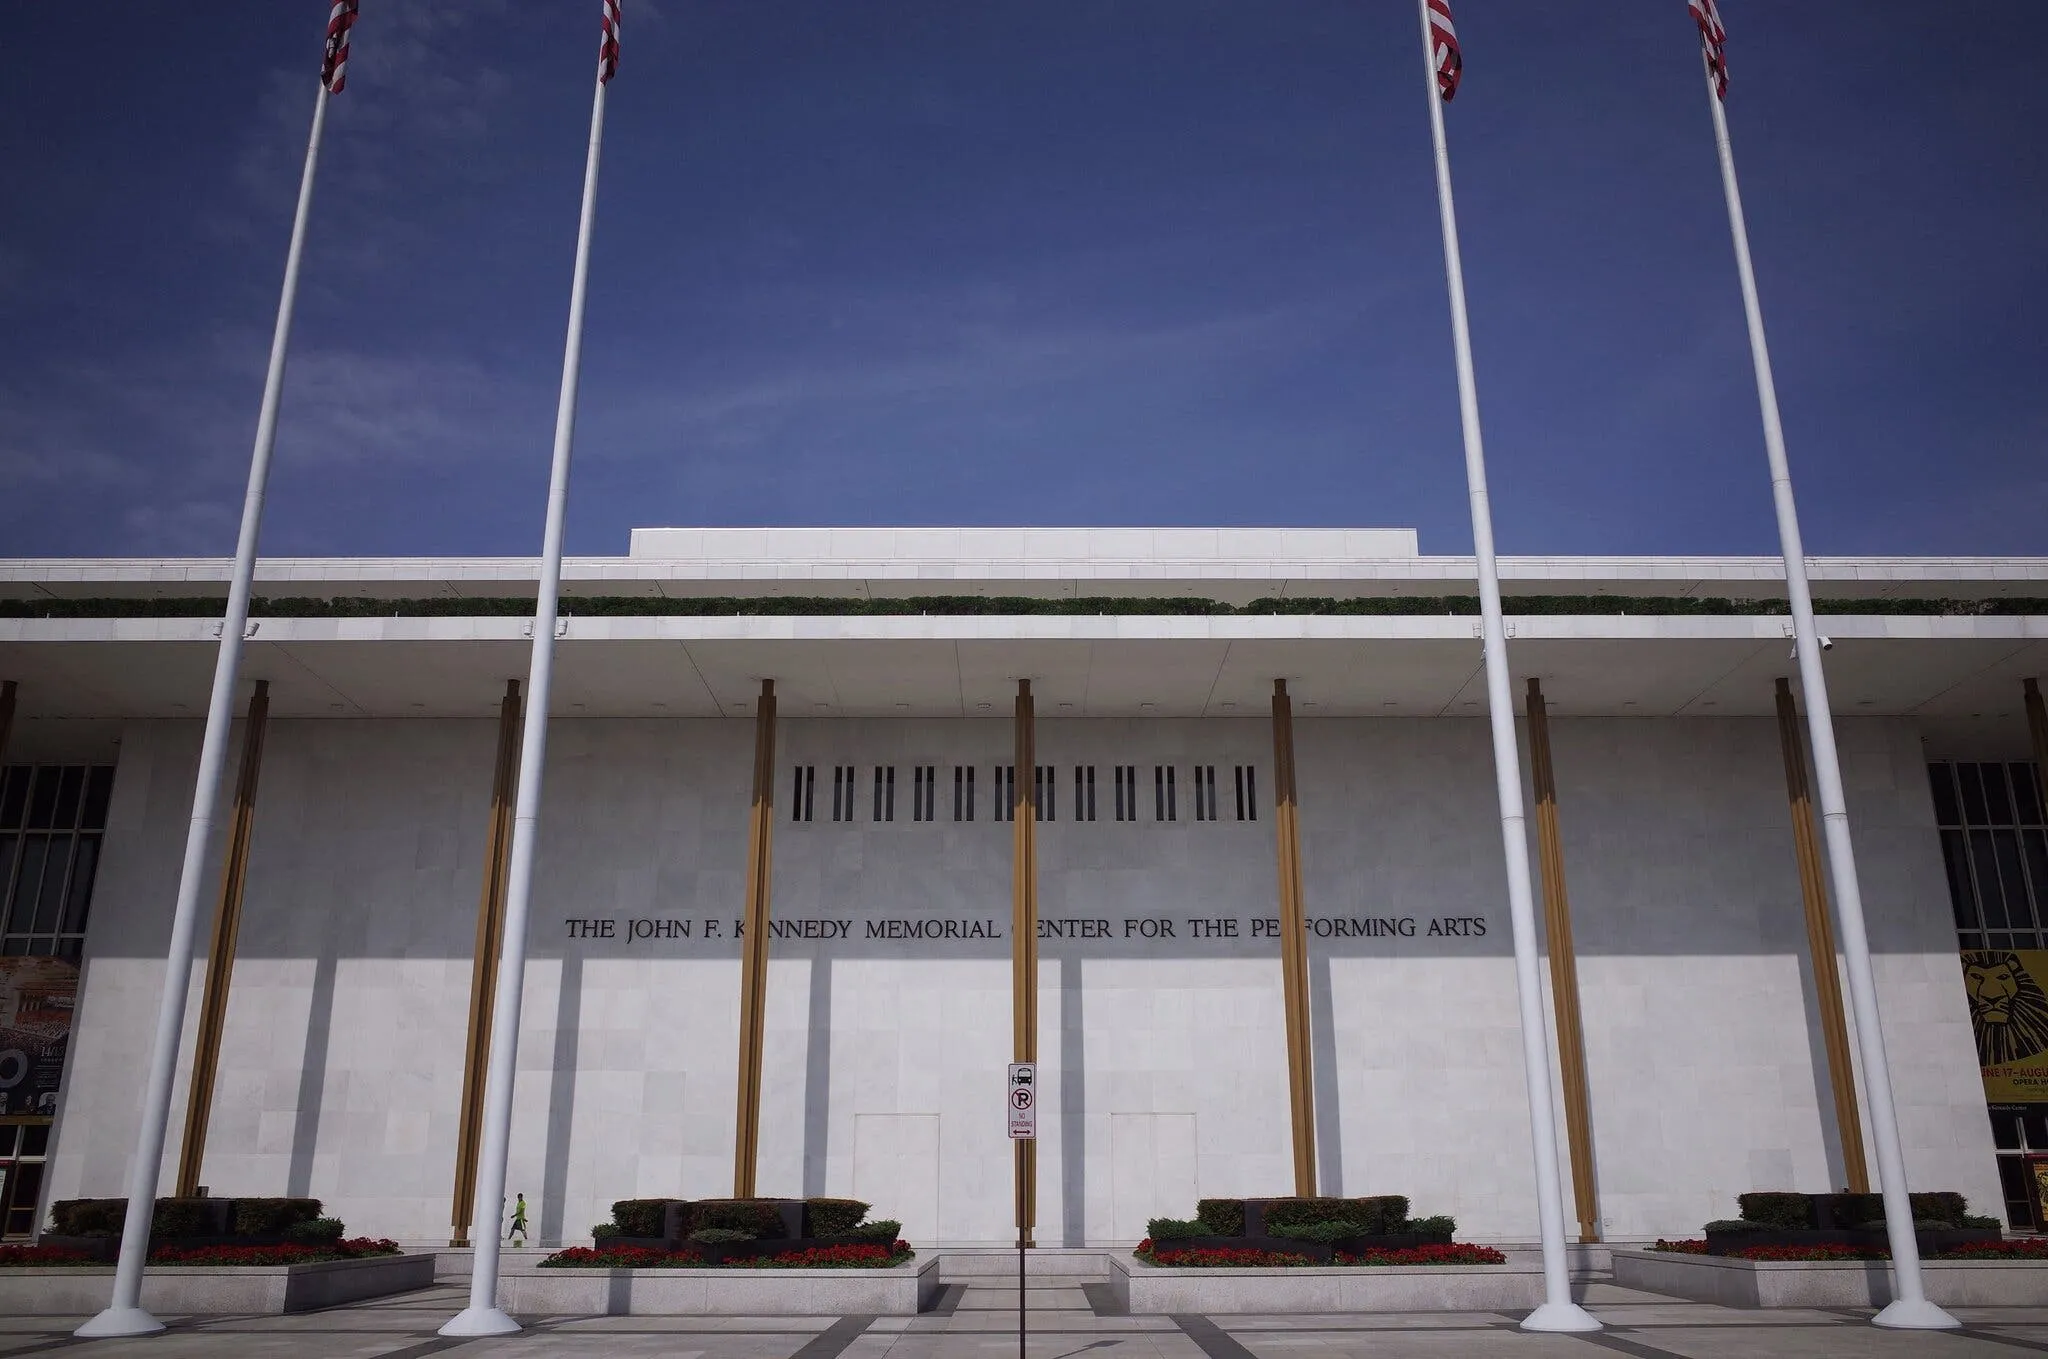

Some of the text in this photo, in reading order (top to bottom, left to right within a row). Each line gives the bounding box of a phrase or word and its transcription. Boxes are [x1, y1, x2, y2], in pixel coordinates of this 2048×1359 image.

[565, 917, 1487, 944] THE JOHN F. KNNEDY MEMORIAL ENTER FOR THE PEORMING ARTS
